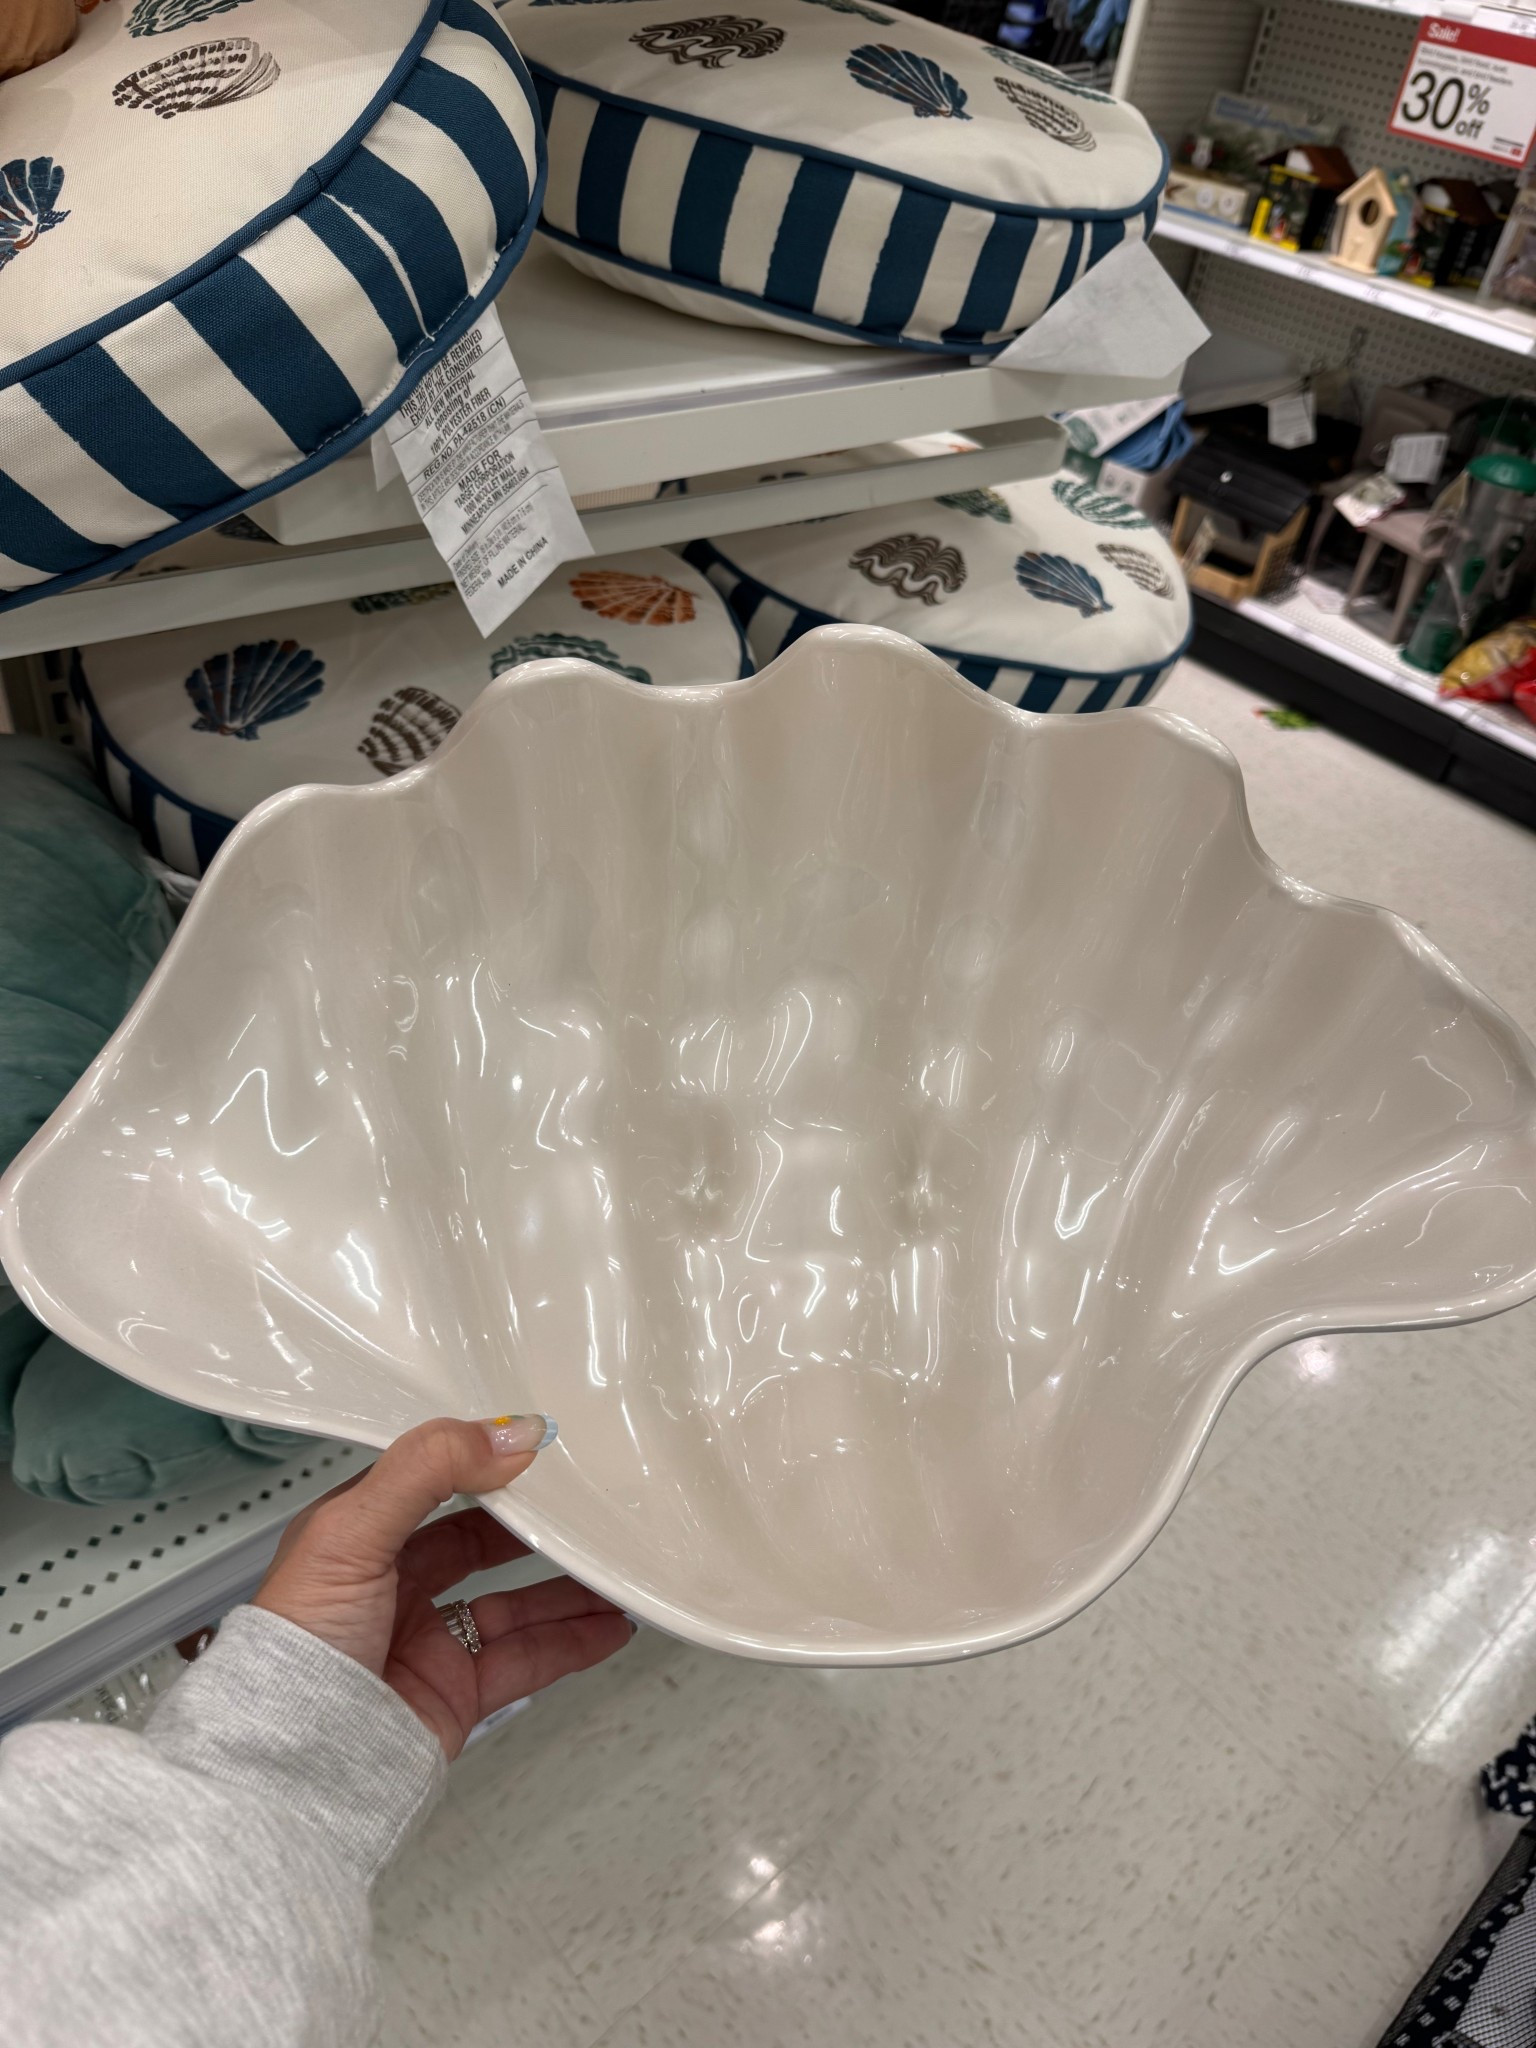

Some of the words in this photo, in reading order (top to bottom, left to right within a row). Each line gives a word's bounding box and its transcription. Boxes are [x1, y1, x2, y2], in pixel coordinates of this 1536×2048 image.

[1427, 22, 1461, 43] Sale!
[1455, 119, 1484, 140] off
[398, 399, 419, 419] THIS
[415, 387, 426, 405] TAG
[424, 373, 435, 393] NOT
[434, 365, 442, 379] TO
[441, 356, 452, 371] BE
[450, 329, 483, 363] REMOVED
[409, 397, 430, 427] EXCEPT
[428, 388, 436, 404] BY
[434, 375, 447, 393] THE
[445, 344, 483, 382] CONSUMER
[425, 412, 435, 429] ALL
[432, 395, 445, 417] NEW
[443, 369, 476, 402] MATERIAL
[430, 435, 445, 456] 100%
[442, 402, 473, 441] POLYESTER
[470, 387, 492, 410] FIBER
[434, 394, 464, 432] consisting
[463, 385, 472, 399] of
[486, 396, 508, 420] (CN)
[454, 483, 476, 508] TARGET
[474, 451, 515, 490] CORPORATION
[458, 464, 482, 492] MADE
[481, 449, 502, 472] FOR
[474, 476, 501, 505] NICOLLET
[499, 465, 517, 483] MALL
[497, 564, 520, 588] MADE
[517, 556, 527, 569] IN
[525, 536, 548, 560] CHINA
